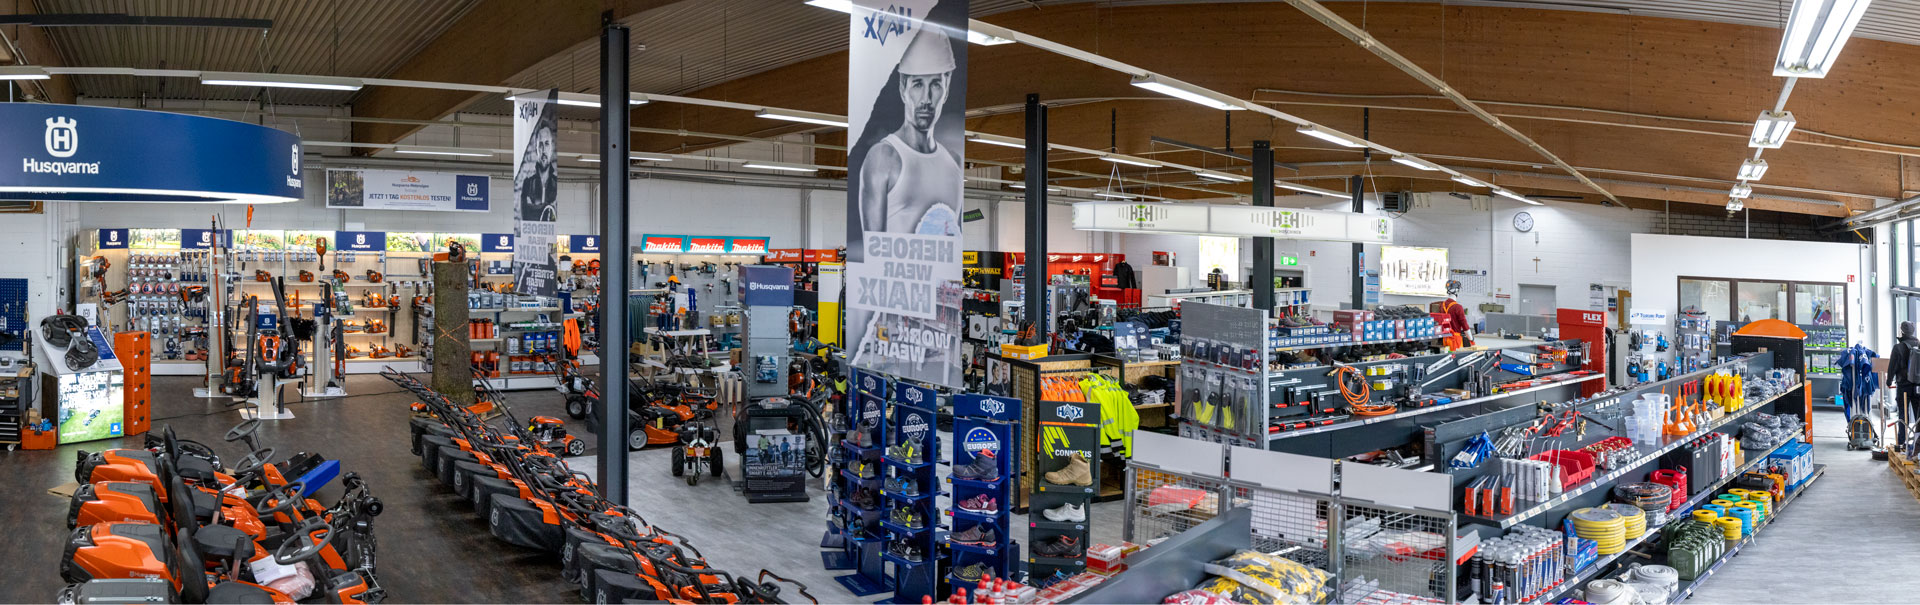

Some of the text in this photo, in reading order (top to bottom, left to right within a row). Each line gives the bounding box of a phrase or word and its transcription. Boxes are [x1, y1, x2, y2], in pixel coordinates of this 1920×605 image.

[23, 158, 99, 176] Husqvarna
[646, 242, 681, 250] makita
[690, 243, 724, 251] makita
[733, 243, 764, 251] makita
[756, 283, 789, 291] Husqvarna
[1583, 312, 1602, 321] FLEX
[981, 398, 1004, 415] HAIX
[1058, 404, 1083, 420] HAIX
[902, 424, 929, 433] EUROPE
[967, 442, 998, 450] EUROPE
[1055, 449, 1092, 458] CONNEXIS
